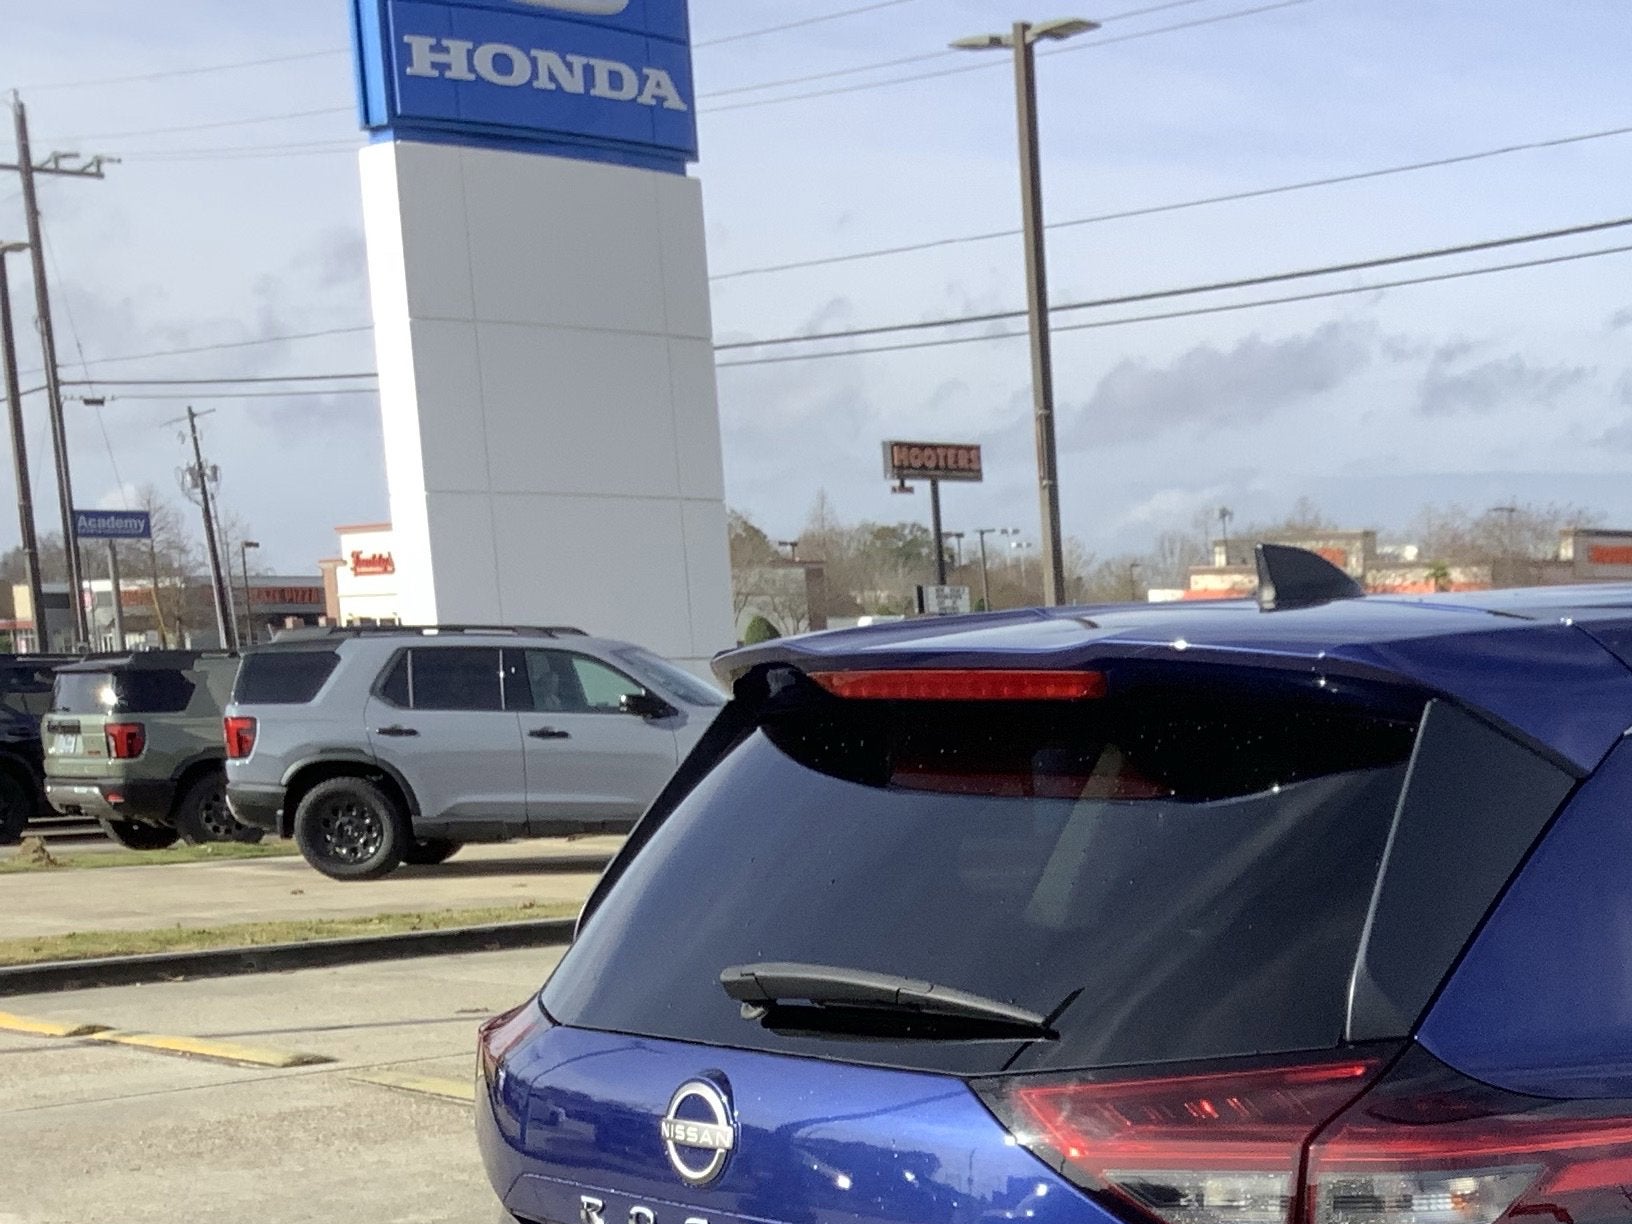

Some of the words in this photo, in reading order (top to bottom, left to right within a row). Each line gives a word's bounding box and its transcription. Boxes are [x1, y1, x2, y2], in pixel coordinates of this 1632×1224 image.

[403, 35, 688, 111] HONDA
[893, 445, 980, 470] HOOTERS
[78, 514, 144, 533] Academy
[661, 1121, 731, 1148] NISSAN
